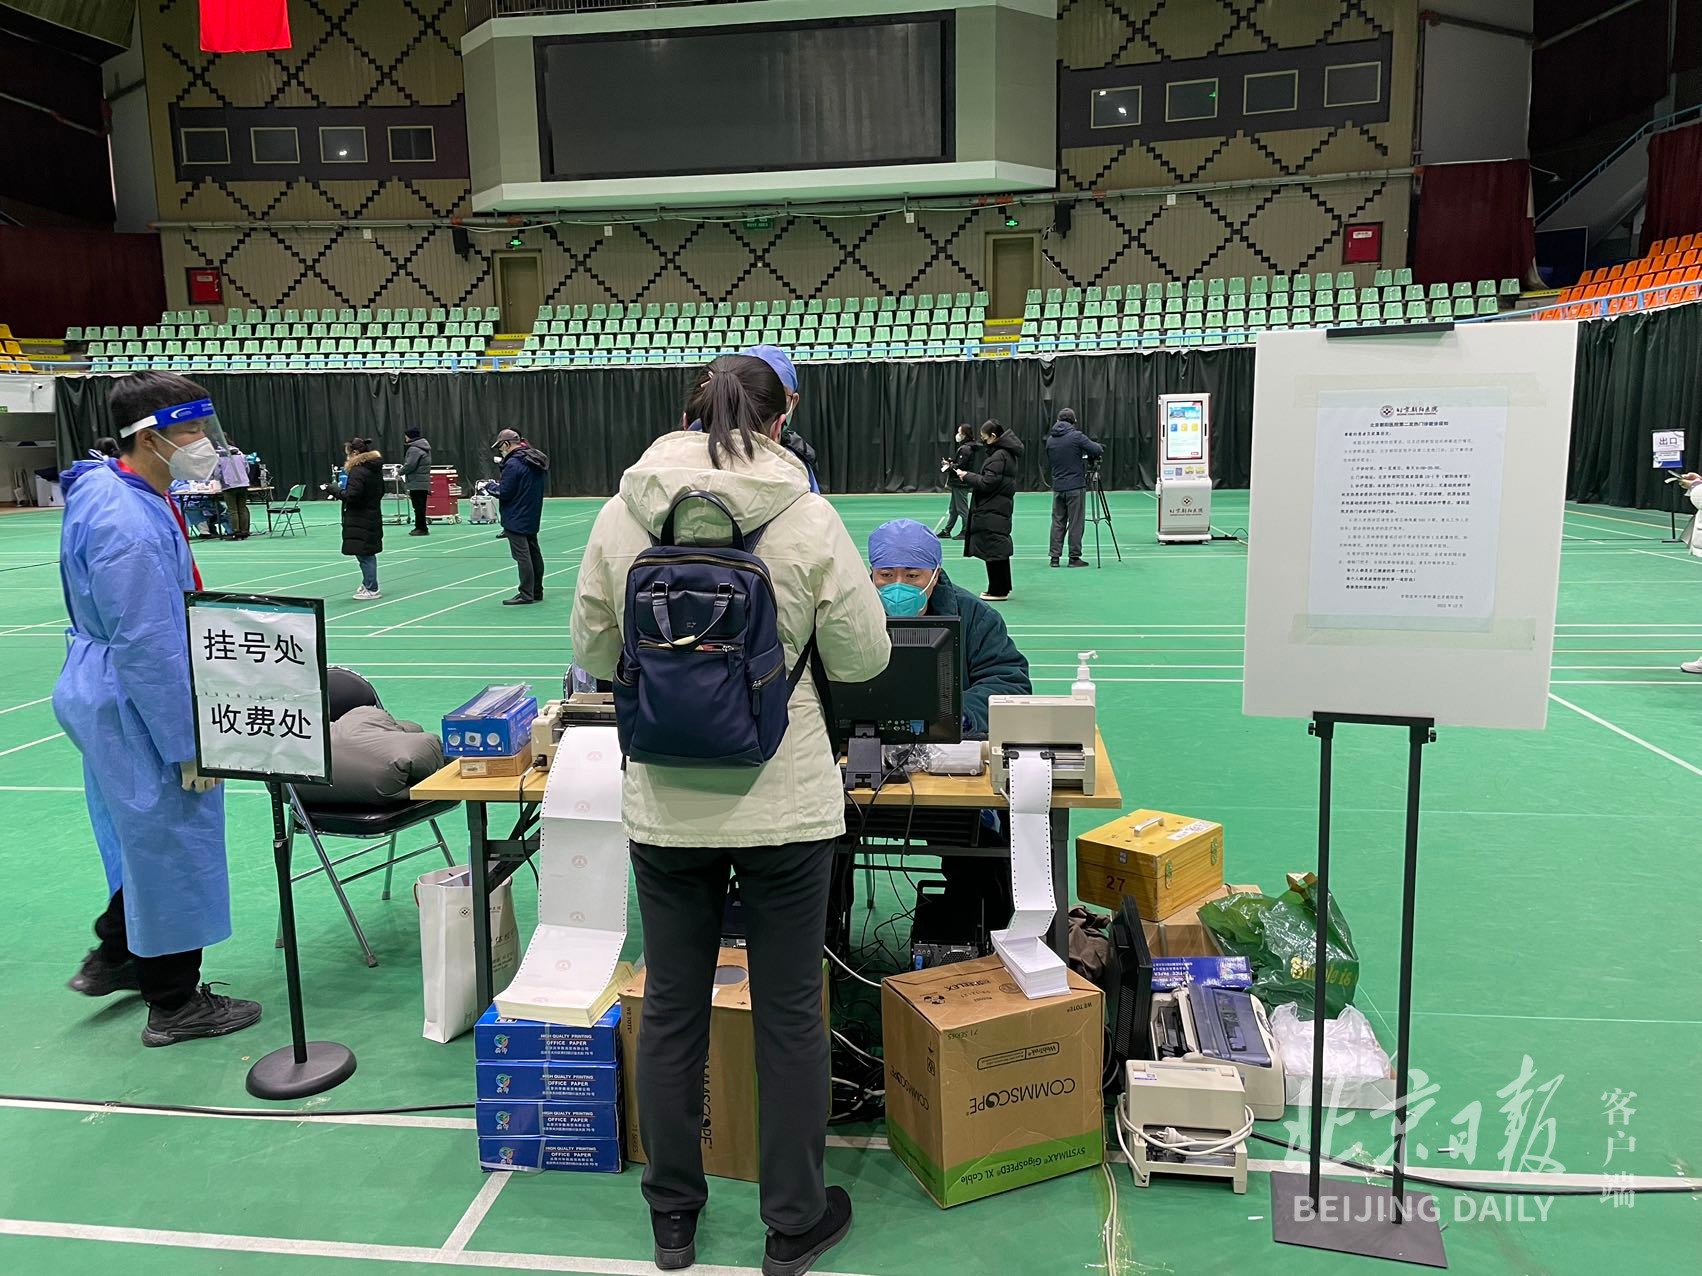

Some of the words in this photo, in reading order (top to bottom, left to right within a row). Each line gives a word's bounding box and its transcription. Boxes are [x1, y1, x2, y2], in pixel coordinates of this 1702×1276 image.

[1659, 437, 1678, 446] 出口
[203, 628, 306, 666] 挂号处
[211, 703, 312, 740] 收费处
[1106, 875, 1126, 892] 27
[961, 1172, 983, 1186] Cable
[986, 1168, 995, 1178] XL
